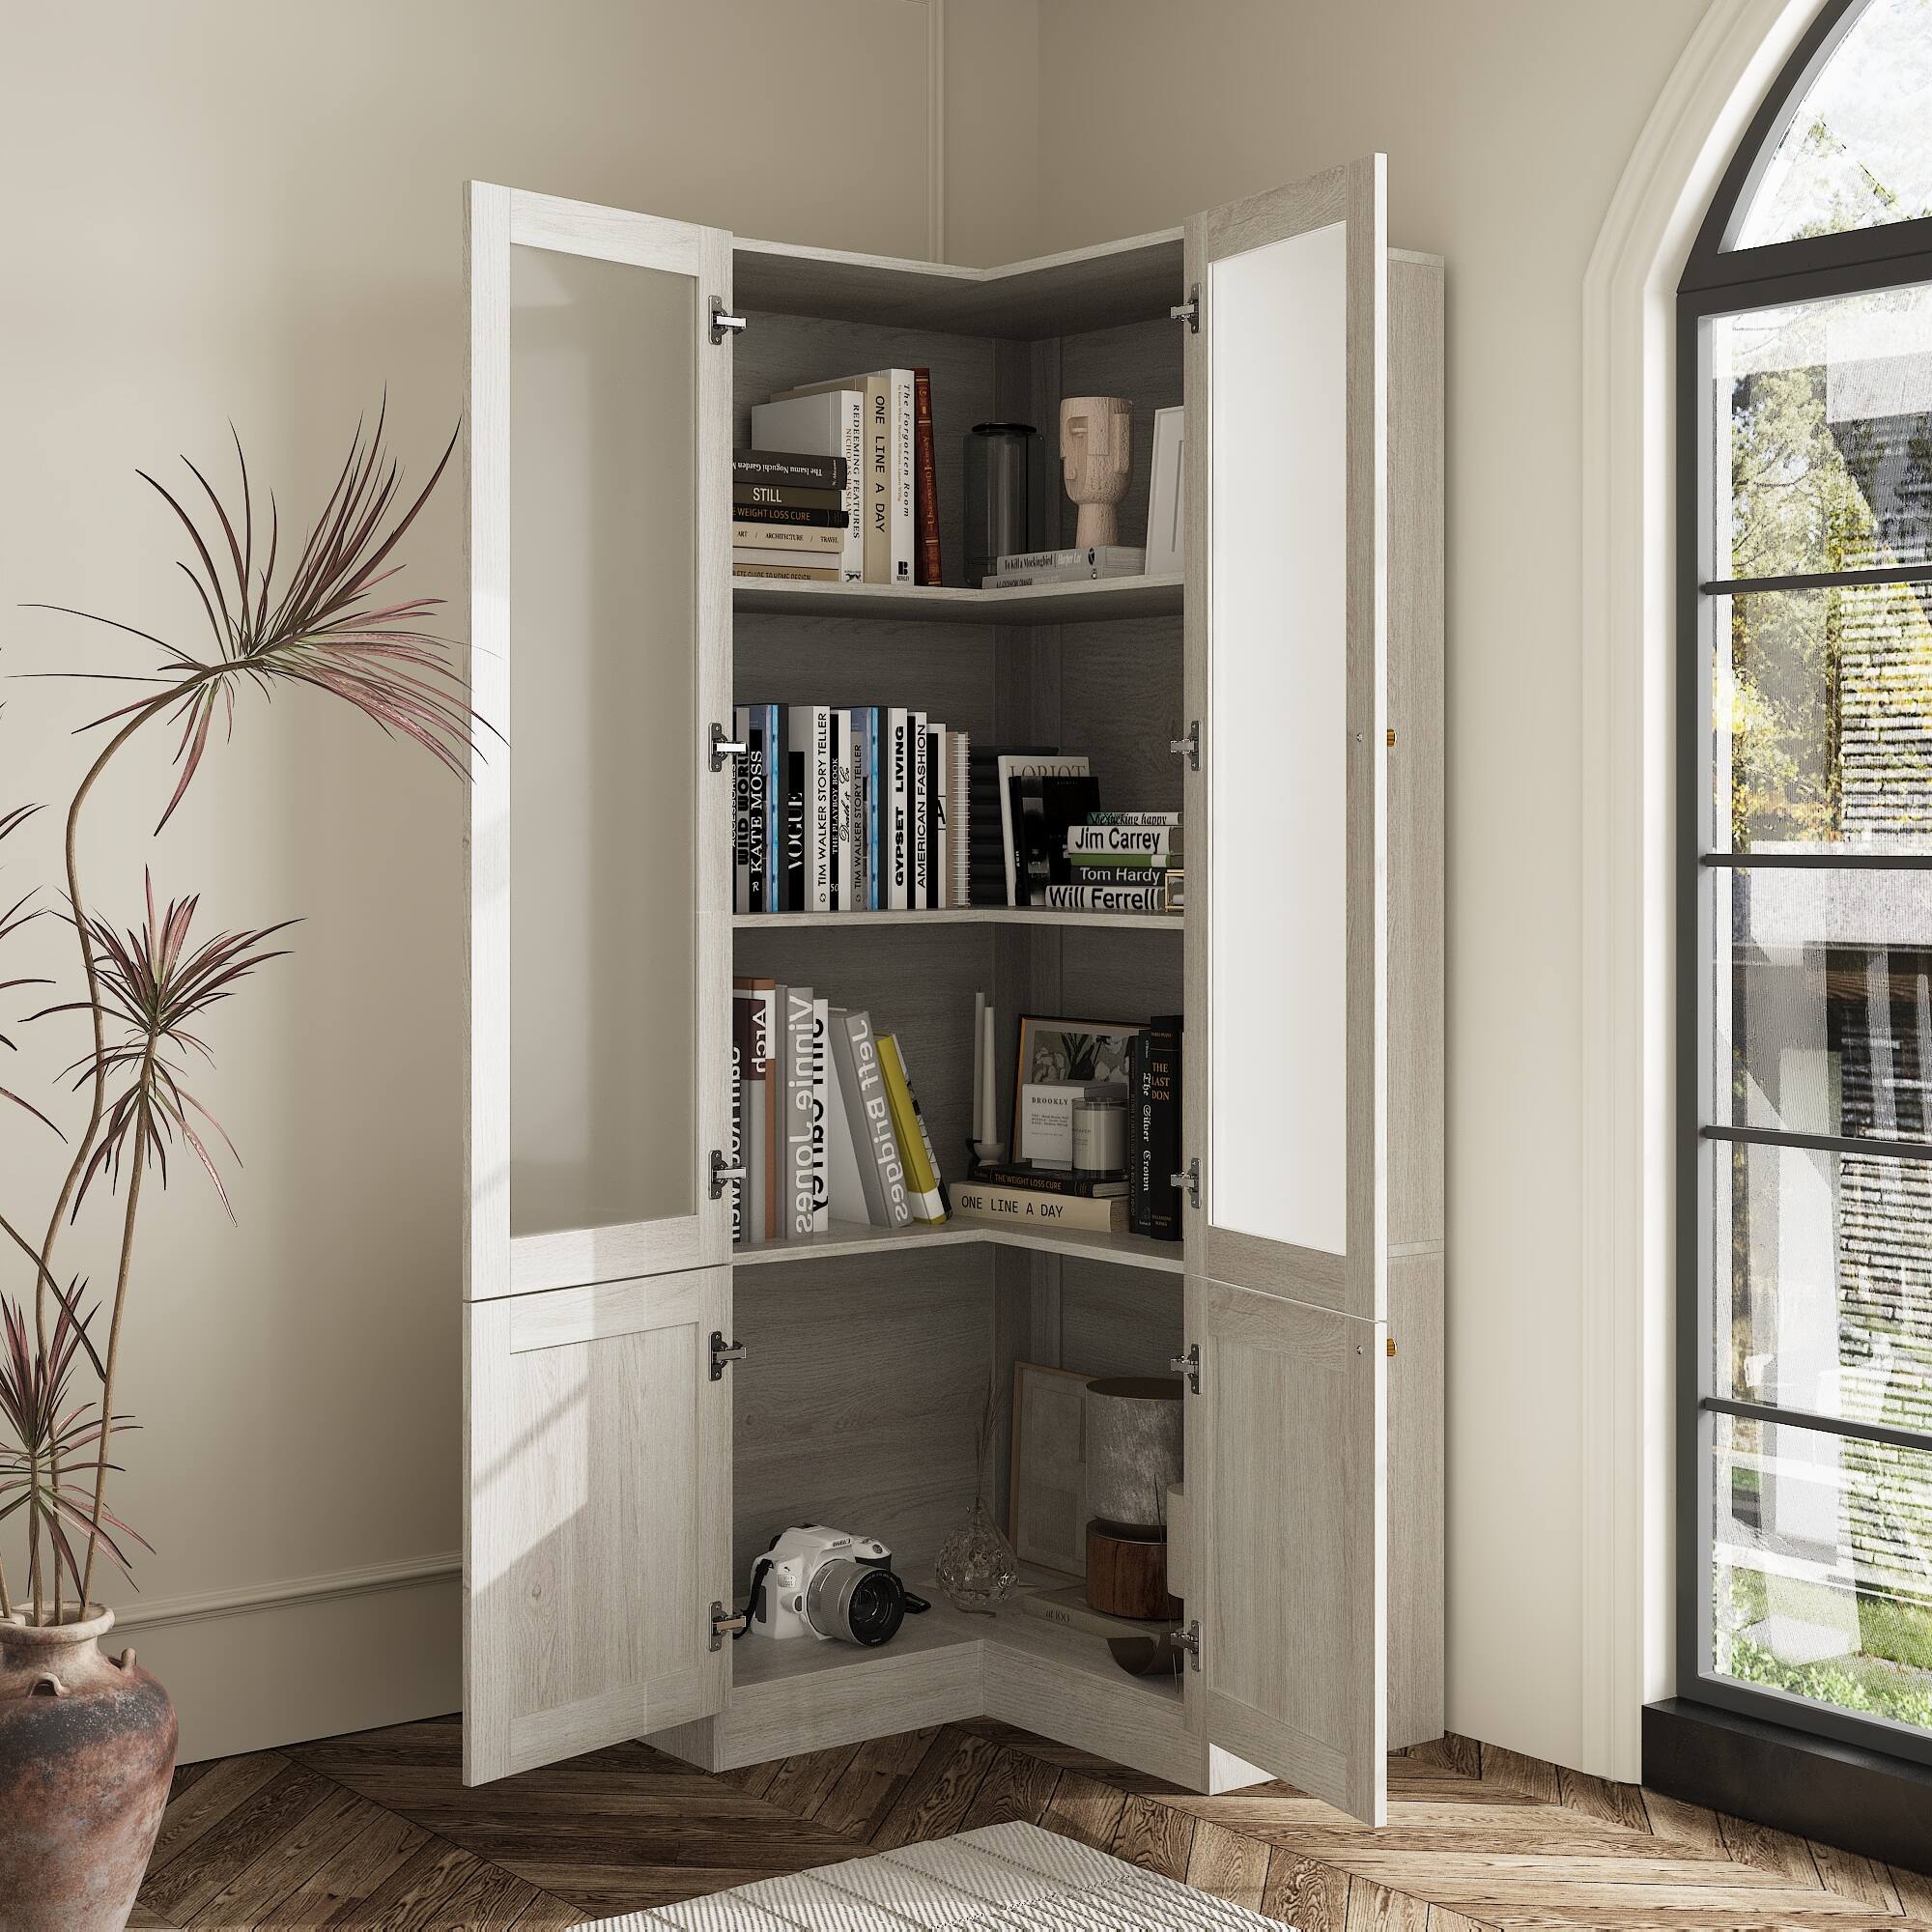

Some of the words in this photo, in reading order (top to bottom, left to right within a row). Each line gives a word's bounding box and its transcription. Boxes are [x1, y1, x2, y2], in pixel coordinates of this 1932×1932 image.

[876, 396, 885, 424] ONE
[876, 436, 885, 473] LINE
[738, 462, 761, 472] Garden
[763, 463, 789, 474] Noguchi
[790, 466, 809, 475] Isamu
[810, 467, 823, 477] The
[753, 487, 782, 503] STILL
[876, 483, 885, 493] A
[738, 507, 767, 517] WEIGHT
[770, 509, 789, 519] LOSS
[791, 511, 811, 521] CURE
[876, 504, 885, 533] DAY
[765, 533, 803, 541] ARCHITECTURE
[1024, 554, 1052, 568] Mockingbird
[818, 713, 826, 761] TELLER
[895, 726, 904, 793] LIVING
[917, 724, 926, 796] FASHION
[738, 742, 748, 811] WORL
[751, 751, 763, 810] MOSS
[818, 763, 826, 804] STORY
[738, 818, 748, 865] WILD
[788, 792, 803, 869] VOGUE
[818, 805, 826, 861] WALKER
[1075, 827, 1104, 849] Jim
[1109, 828, 1160, 854] Carrey
[751, 816, 763, 873] KATE
[895, 806, 904, 886] GYPSET
[917, 802, 926, 888] AMERICAN
[818, 863, 826, 887] TIM
[1080, 868, 1110, 881] Tom
[1116, 868, 1160, 885] Hardy
[1049, 887, 1085, 907] Will
[1092, 888, 1155, 909] Ferrell
[1152, 1063, 1168, 1073] THE
[1143, 1073, 1151, 1096] The
[1152, 1077, 1170, 1087] LAST
[1152, 1090, 1169, 1100] DON
[1006, 1176, 1029, 1186] WEIGHT
[1030, 1178, 1045, 1188] LOSS
[1046, 1180, 1062, 1190] CURE
[961, 1195, 982, 1209] ONE
[991, 1199, 1018, 1213] LINE
[1026, 1203, 1034, 1215] A
[1041, 1205, 1063, 1218] DAY
